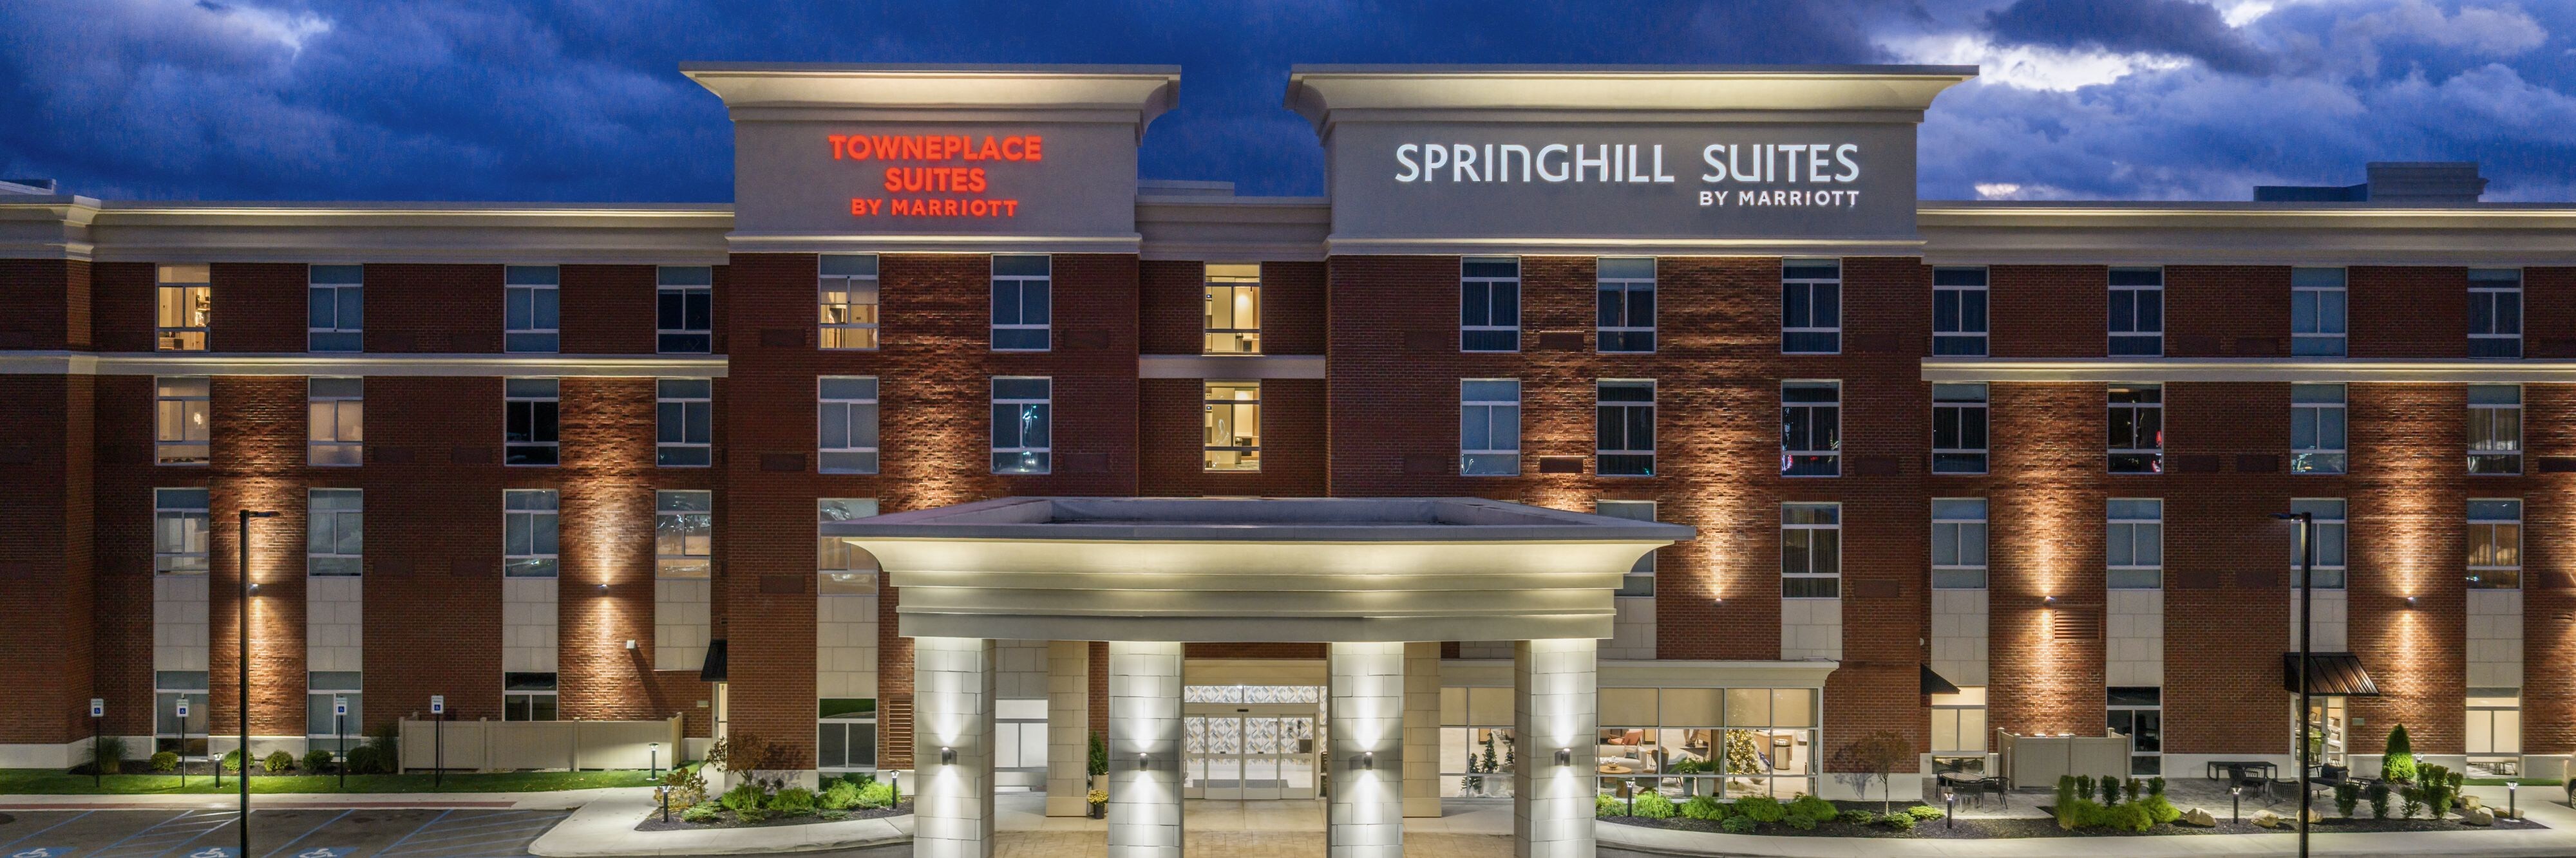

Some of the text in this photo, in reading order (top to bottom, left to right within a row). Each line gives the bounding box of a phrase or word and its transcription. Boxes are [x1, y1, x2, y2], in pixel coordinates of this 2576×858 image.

[828, 135, 1042, 161] TOWNEPLACE
[1395, 144, 1859, 182] SPRINGHILL SUITES
[884, 167, 987, 192] SUITES
[851, 198, 1018, 217] BY MARRIOTT
[1699, 191, 1859, 207] BY MARRIOTT
